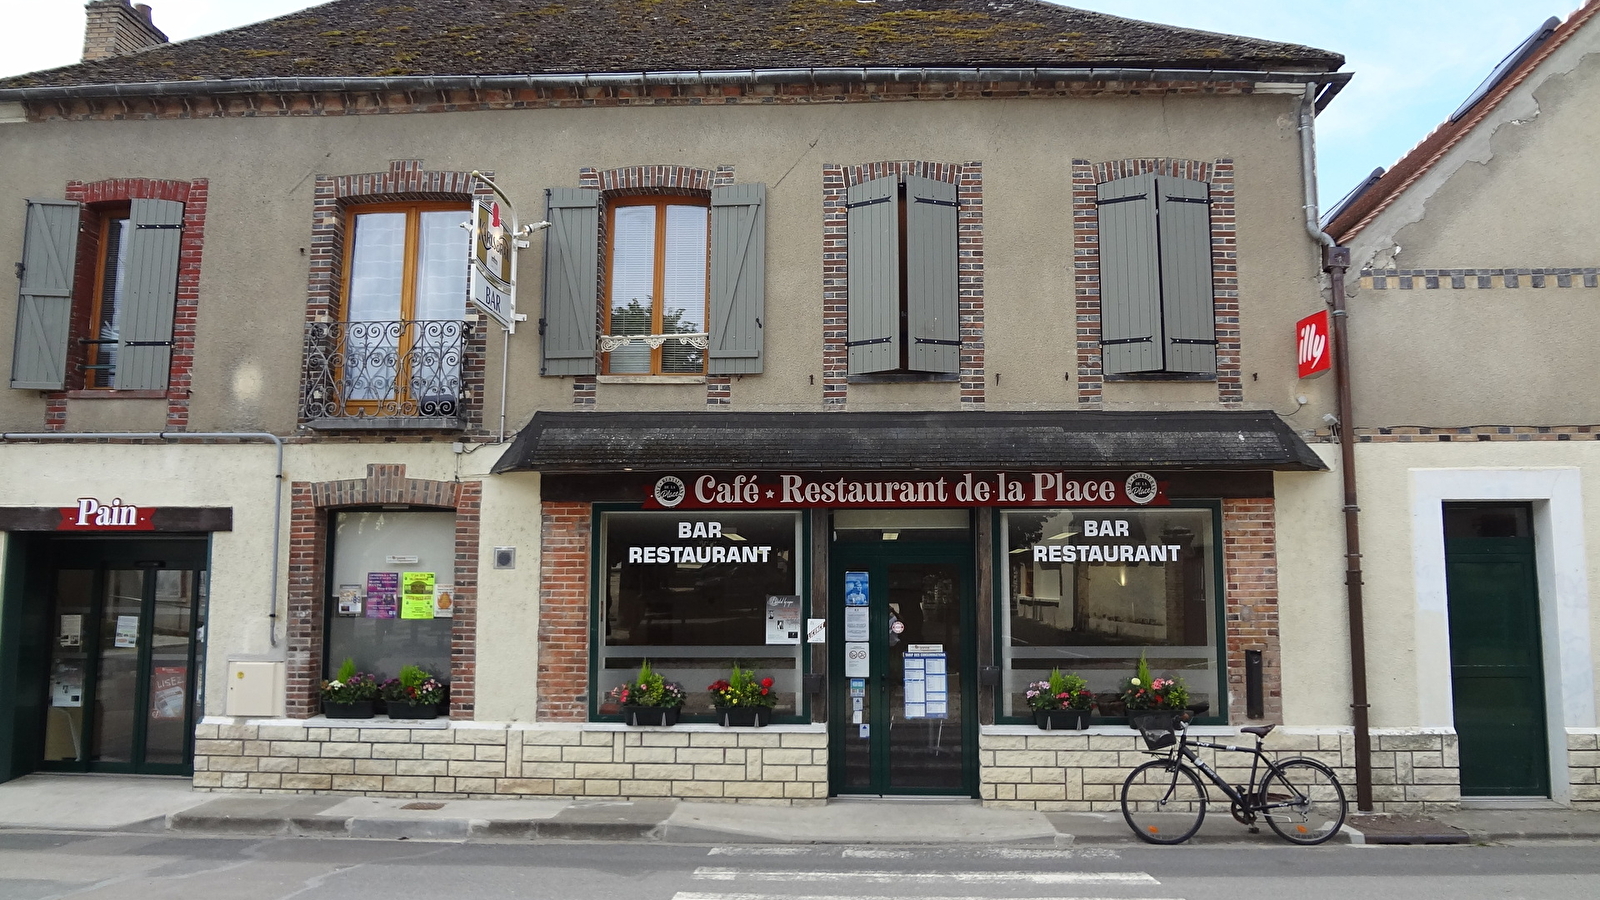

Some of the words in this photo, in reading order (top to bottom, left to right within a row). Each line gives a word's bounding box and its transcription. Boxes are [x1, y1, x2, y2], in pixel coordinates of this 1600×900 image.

[486, 286, 501, 313] BAR
[1299, 323, 1326, 369] illy
[694, 474, 759, 504] Café
[780, 474, 948, 503] Restaurant
[955, 473, 991, 502] de
[997, 472, 1025, 502] la
[1032, 472, 1116, 502] Place
[75, 497, 137, 526] Pain
[678, 521, 722, 539] BAR
[1084, 520, 1129, 537] BAR
[628, 546, 772, 564] RESTAURANT
[1033, 545, 1181, 562] RESTAURANT
[157, 676, 184, 689] LISEZ
